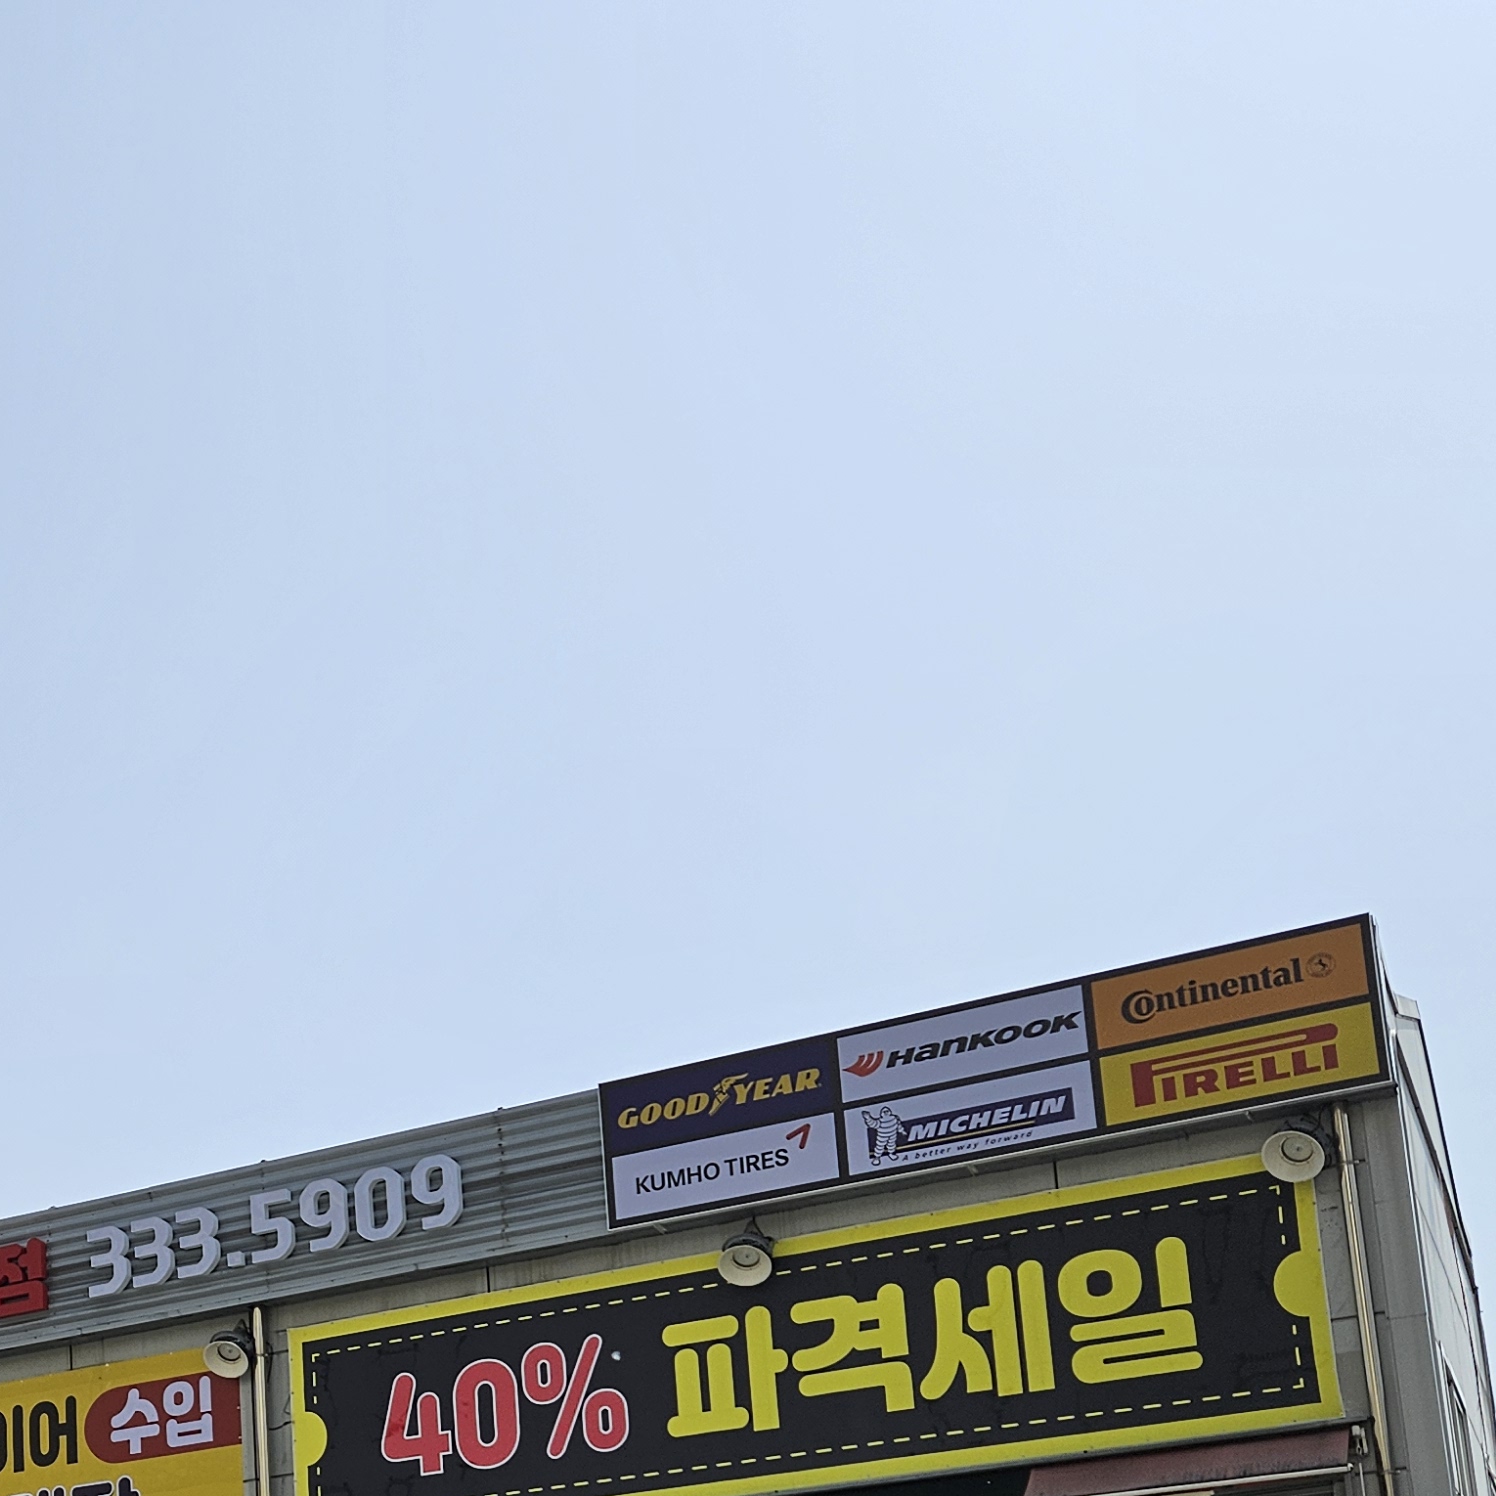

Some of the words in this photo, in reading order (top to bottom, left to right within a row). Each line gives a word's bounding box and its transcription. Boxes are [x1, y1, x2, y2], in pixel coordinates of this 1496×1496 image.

[1121, 957, 1304, 1024] Continental
[1130, 1023, 1339, 1108] PIRELLI
[907, 1094, 1066, 1142] MICHELIN
[914, 1145, 952, 1160] better
[956, 1141, 980, 1152] way
[985, 1130, 1034, 1146] forward
[636, 1161, 721, 1195] KUMHO
[723, 1148, 790, 1177] TIRES
[87, 1154, 464, 1299] 333.5909
[381, 1333, 630, 1477] 40%
[662, 1235, 1204, 1438] 파격세일
[110, 1376, 214, 1456] 수입
